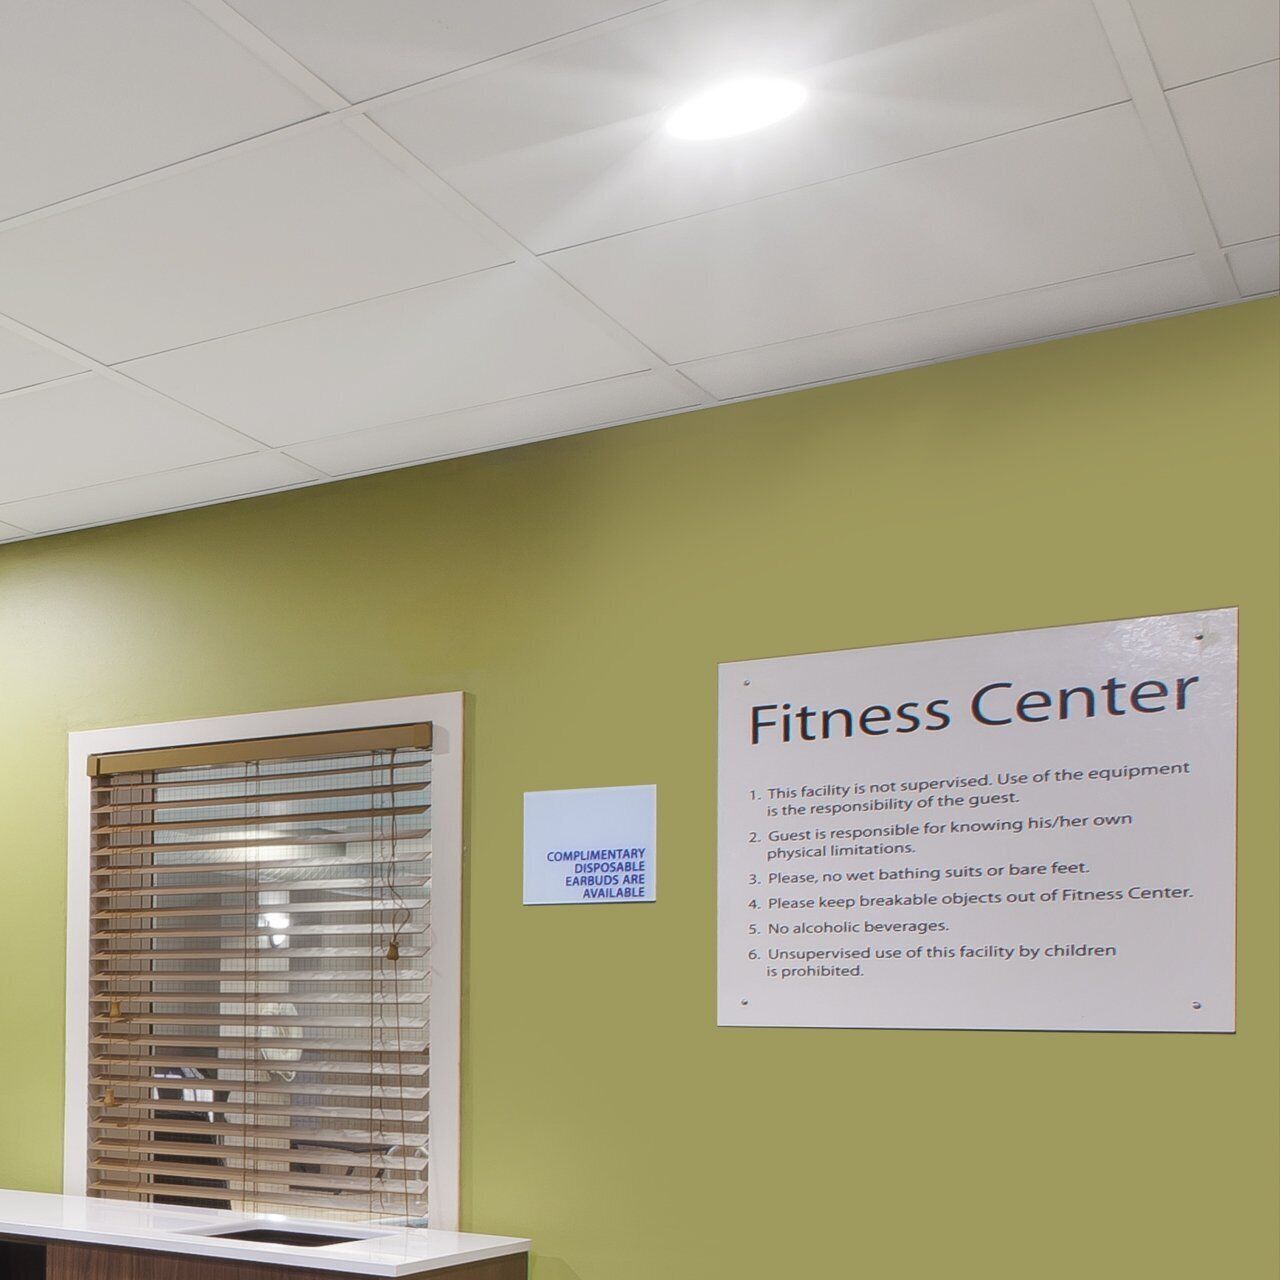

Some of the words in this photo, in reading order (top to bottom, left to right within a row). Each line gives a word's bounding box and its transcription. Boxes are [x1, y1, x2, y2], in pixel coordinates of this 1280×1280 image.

[751, 699, 951, 745] Fitness
[971, 676, 1199, 726] Center
[750, 790, 761, 800] 1.
[767, 787, 797, 799] This
[801, 784, 851, 798] facility
[854, 783, 866, 794] is
[870, 782, 896, 793] not
[900, 774, 993, 793] supervised.
[997, 773, 1028, 785] Use
[1032, 769, 1051, 783] of
[1054, 769, 1084, 781] the
[1088, 762, 1190, 781] equipment
[767, 806, 778, 817] is
[781, 804, 806, 816] the
[810, 798, 914, 816] responsibility
[917, 795, 935, 808] of
[937, 794, 965, 807] the
[968, 793, 1020, 808] guest.
[748, 832, 761, 843] 2.
[768, 830, 811, 842] Guest
[815, 828, 826, 840] is
[830, 823, 920, 841] responsible
[923, 822, 947, 834] for
[950, 819, 1023, 833] knowing
[1028, 815, 1089, 829] his/her
[1093, 815, 1132, 826] own
[547, 848, 646, 862] COMPLIMENTARY
[767, 845, 826, 862] physical
[831, 843, 916, 856] limitations.
[574, 860, 646, 874] DISPOSABLE
[748, 874, 761, 885] 3.
[769, 872, 819, 884] Please,
[822, 873, 842, 882] no
[846, 871, 875, 881] wet
[879, 867, 941, 882] bathing
[945, 866, 983, 878] suits
[987, 867, 1005, 876] or
[1009, 863, 1047, 876] bare
[1051, 861, 1090, 874] feet.
[565, 875, 619, 887] EARBUDS
[622, 873, 645, 885] ARE
[583, 886, 645, 899] AVAILABLE
[748, 899, 761, 909] 4.
[768, 897, 815, 909] Please
[819, 896, 856, 910] keep
[860, 893, 938, 907] breakable
[941, 892, 1002, 907] objects
[1006, 892, 1036, 903] out
[1040, 889, 1059, 902] of
[1062, 889, 1123, 901] Fitness
[1128, 887, 1194, 899] Center.
[749, 924, 761, 935] 5.
[768, 923, 789, 934] No
[793, 921, 860, 934] alcoholic
[864, 921, 949, 935] beverages.
[748, 949, 761, 960] 6.
[768, 947, 871, 962] Unsupervised
[875, 950, 902, 959] use
[906, 946, 923, 958] of
[926, 946, 956, 958] this
[960, 945, 1015, 960] facility
[1019, 945, 1040, 960] by
[1044, 944, 1116, 957] children
[767, 966, 778, 977] is
[781, 965, 864, 979] prohibited.
